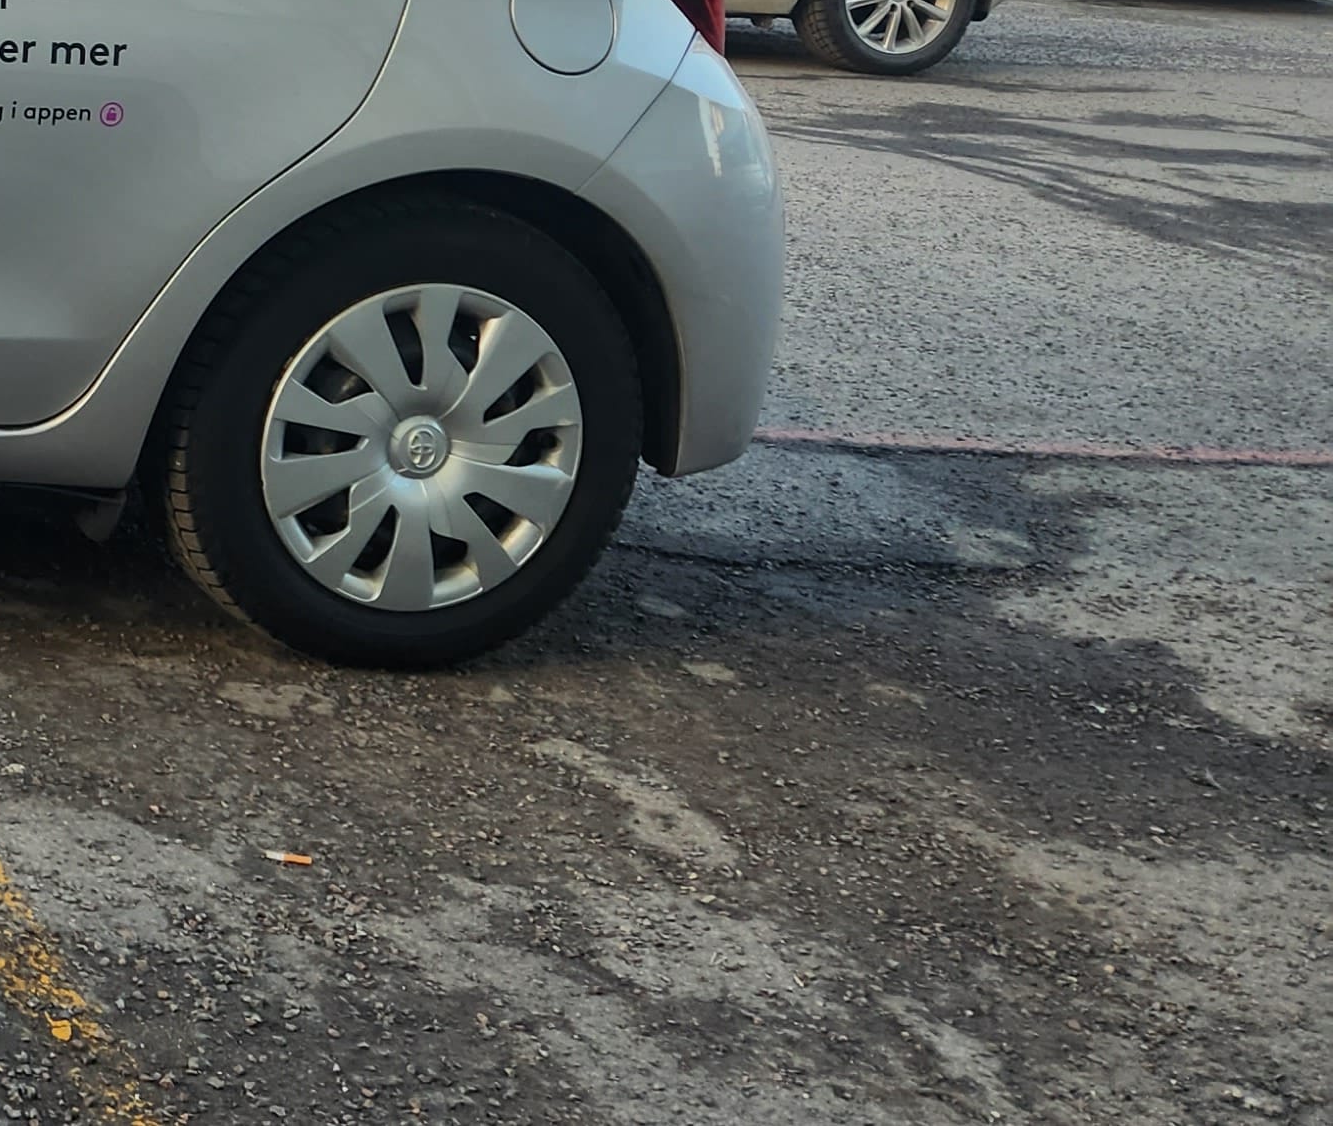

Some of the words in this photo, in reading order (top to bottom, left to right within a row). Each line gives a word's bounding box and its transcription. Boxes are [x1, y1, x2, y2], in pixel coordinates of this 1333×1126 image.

[50, 39, 128, 67] mer
[10, 100, 19, 119] i
[23, 107, 92, 126] appen
